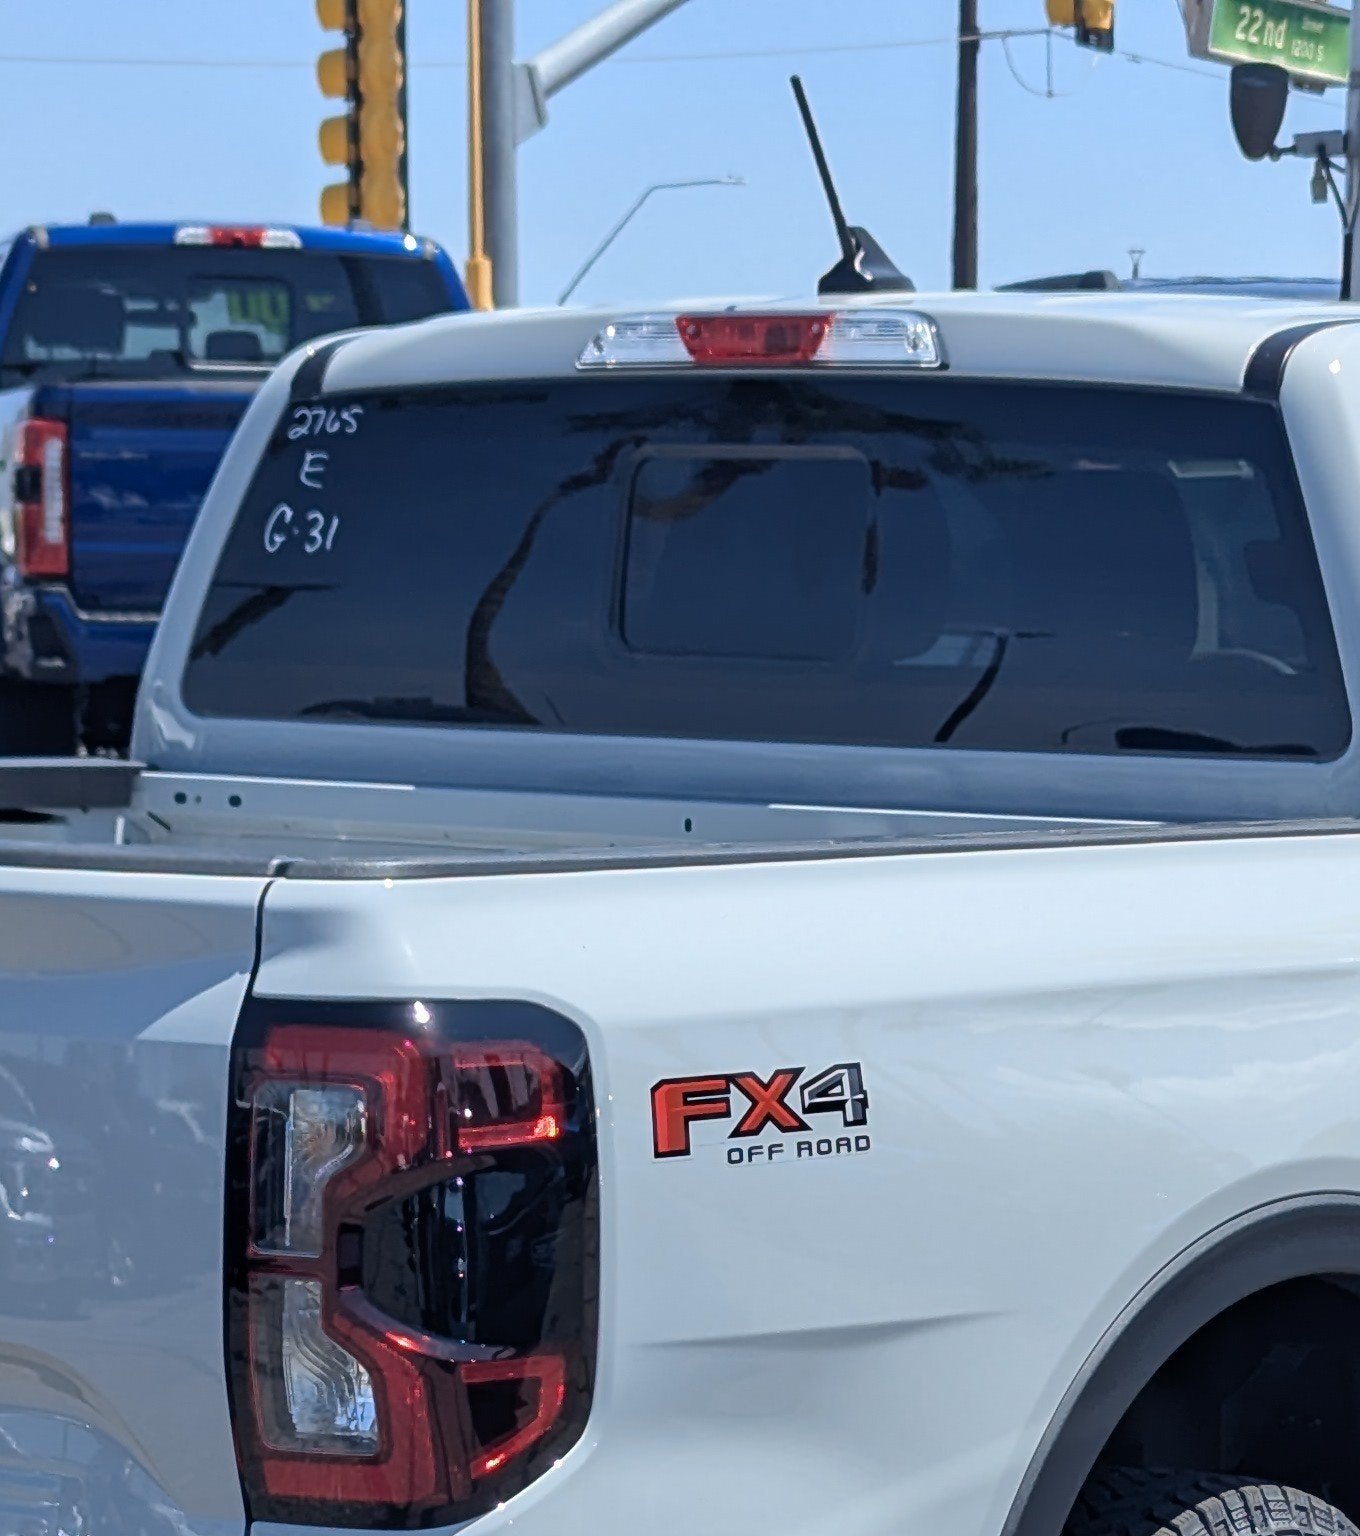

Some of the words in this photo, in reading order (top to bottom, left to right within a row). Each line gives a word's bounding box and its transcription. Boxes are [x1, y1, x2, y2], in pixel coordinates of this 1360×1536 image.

[1235, 5, 1288, 50] 22nd
[288, 404, 364, 440] 2765
[299, 451, 330, 489] E
[650, 1062, 869, 1158] FX4
[727, 1142, 784, 1165] OFF
[797, 1134, 871, 1158] ROAD
